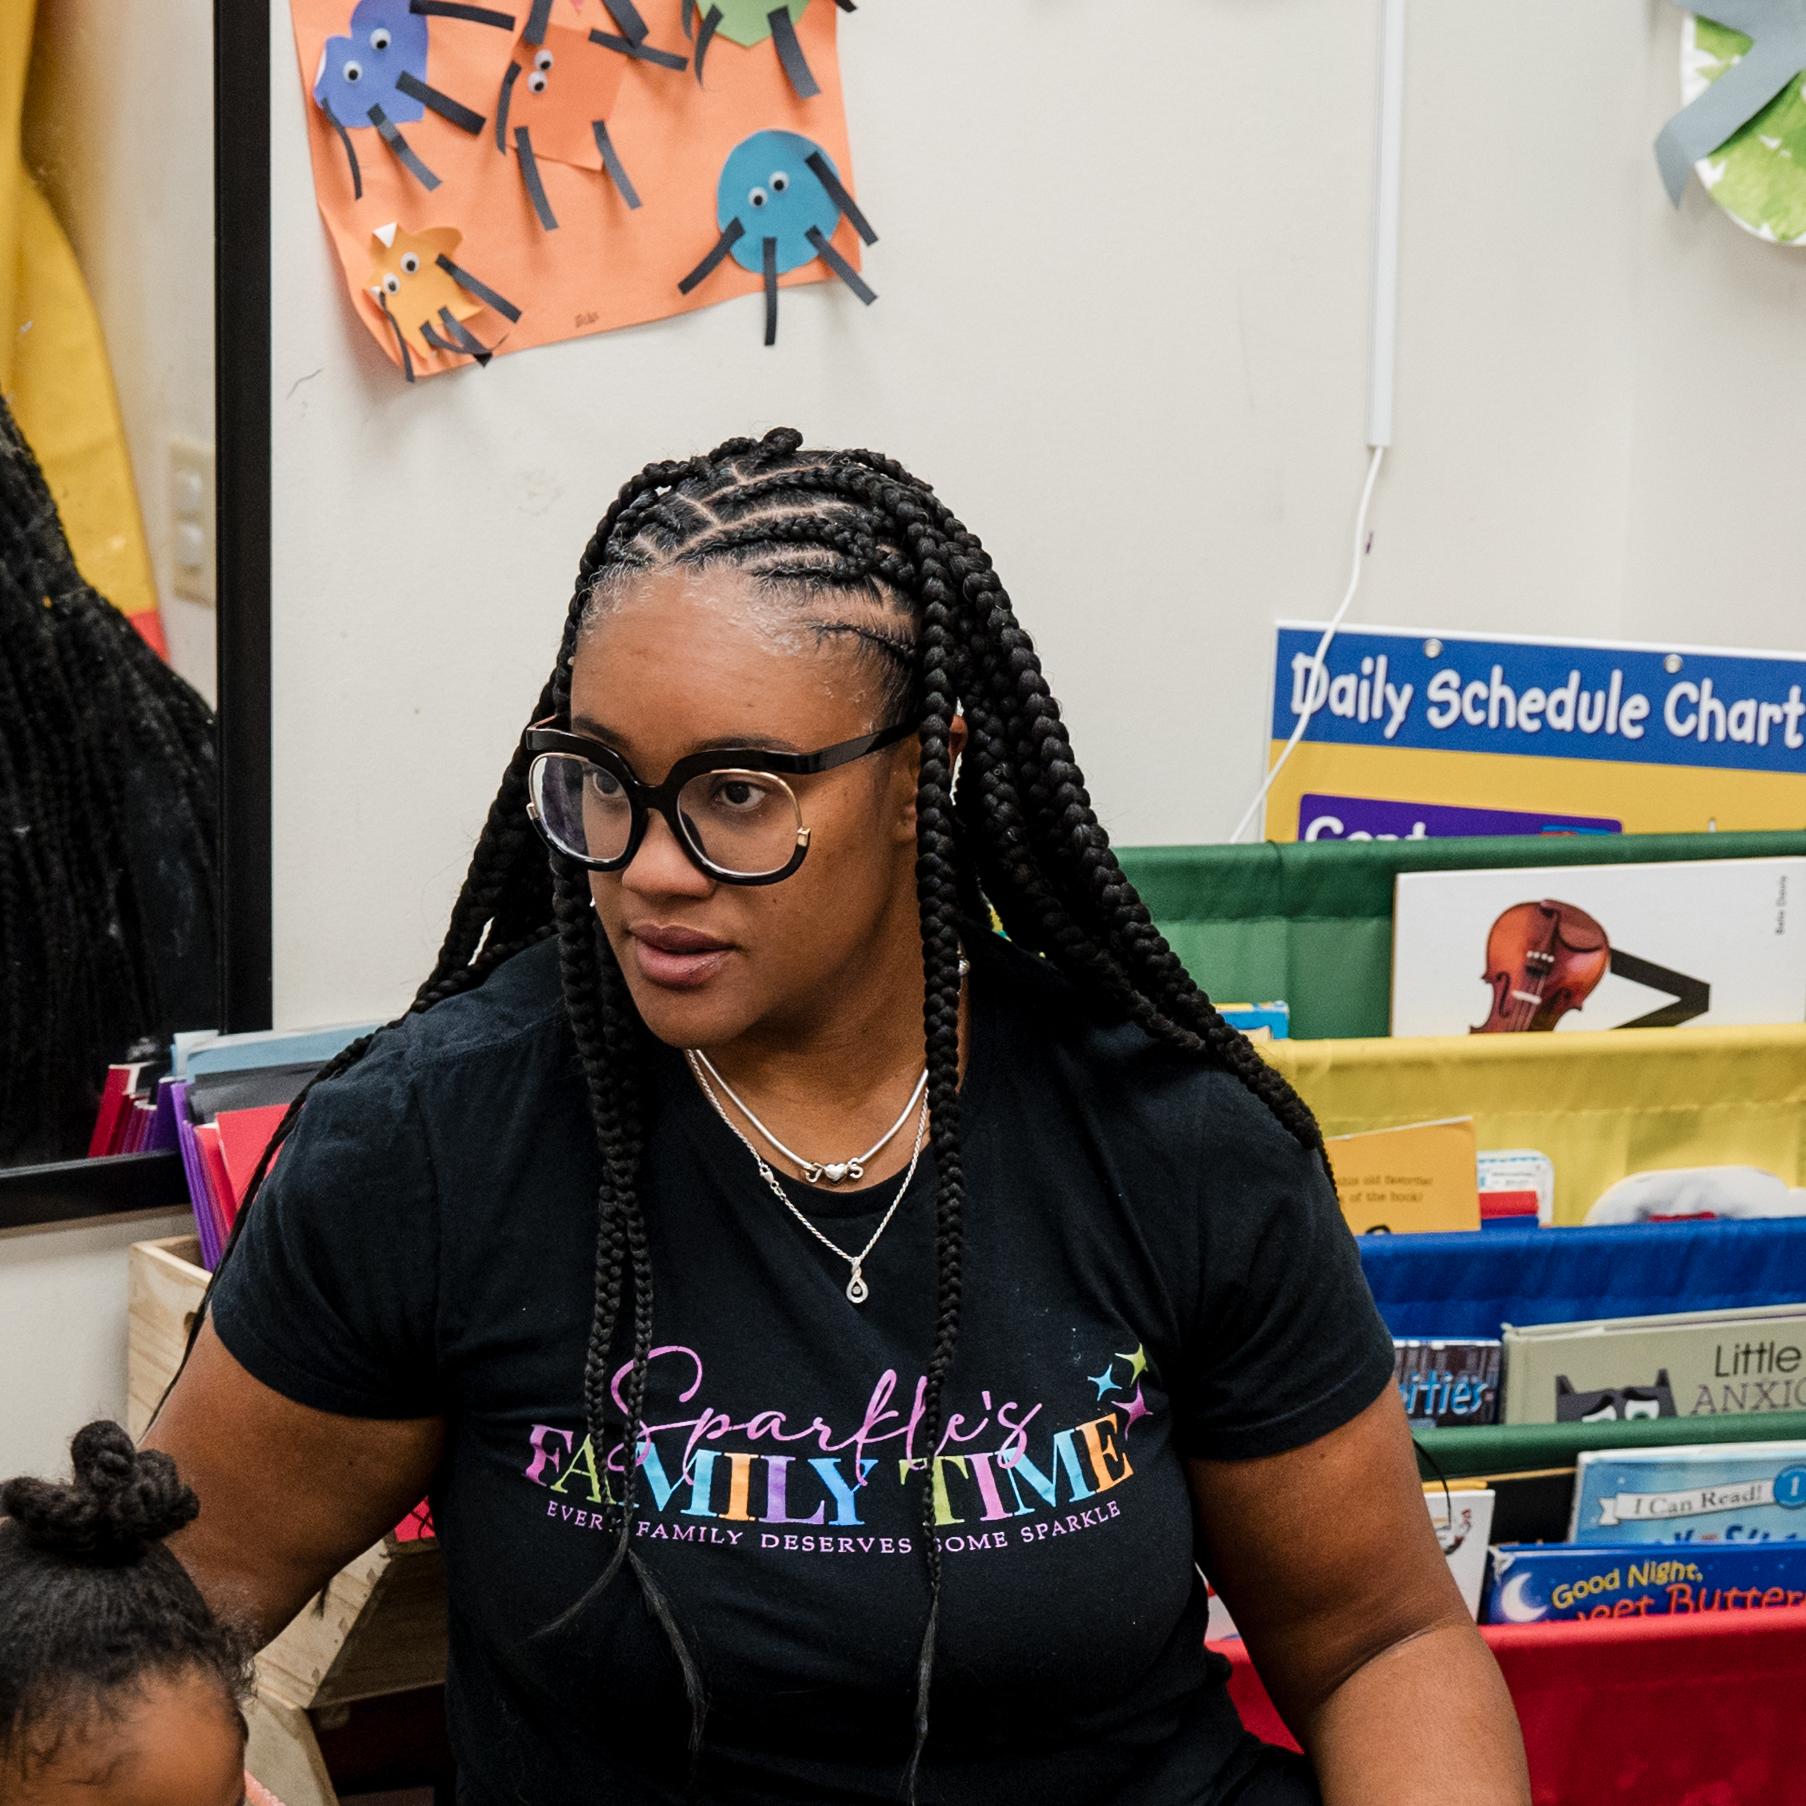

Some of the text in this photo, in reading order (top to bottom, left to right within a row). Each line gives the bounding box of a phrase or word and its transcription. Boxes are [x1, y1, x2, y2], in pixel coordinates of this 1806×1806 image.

[1292, 654, 1806, 748] Daily Schedule Chart
[1715, 1341, 1801, 1378] Little
[608, 1345, 1043, 1487] Sparkle's
[524, 1412, 1134, 1528] FAMILY TIME
[1790, 1476, 1800, 1496] 1
[1634, 1486, 1763, 1514] I Can Read!
[547, 1501, 620, 1533] EVER
[635, 1520, 745, 1547] FAMILY
[760, 1534, 912, 1555] DESERVES
[1021, 1501, 1122, 1544] SPARKLE
[1551, 1561, 1703, 1609] Good Night,
